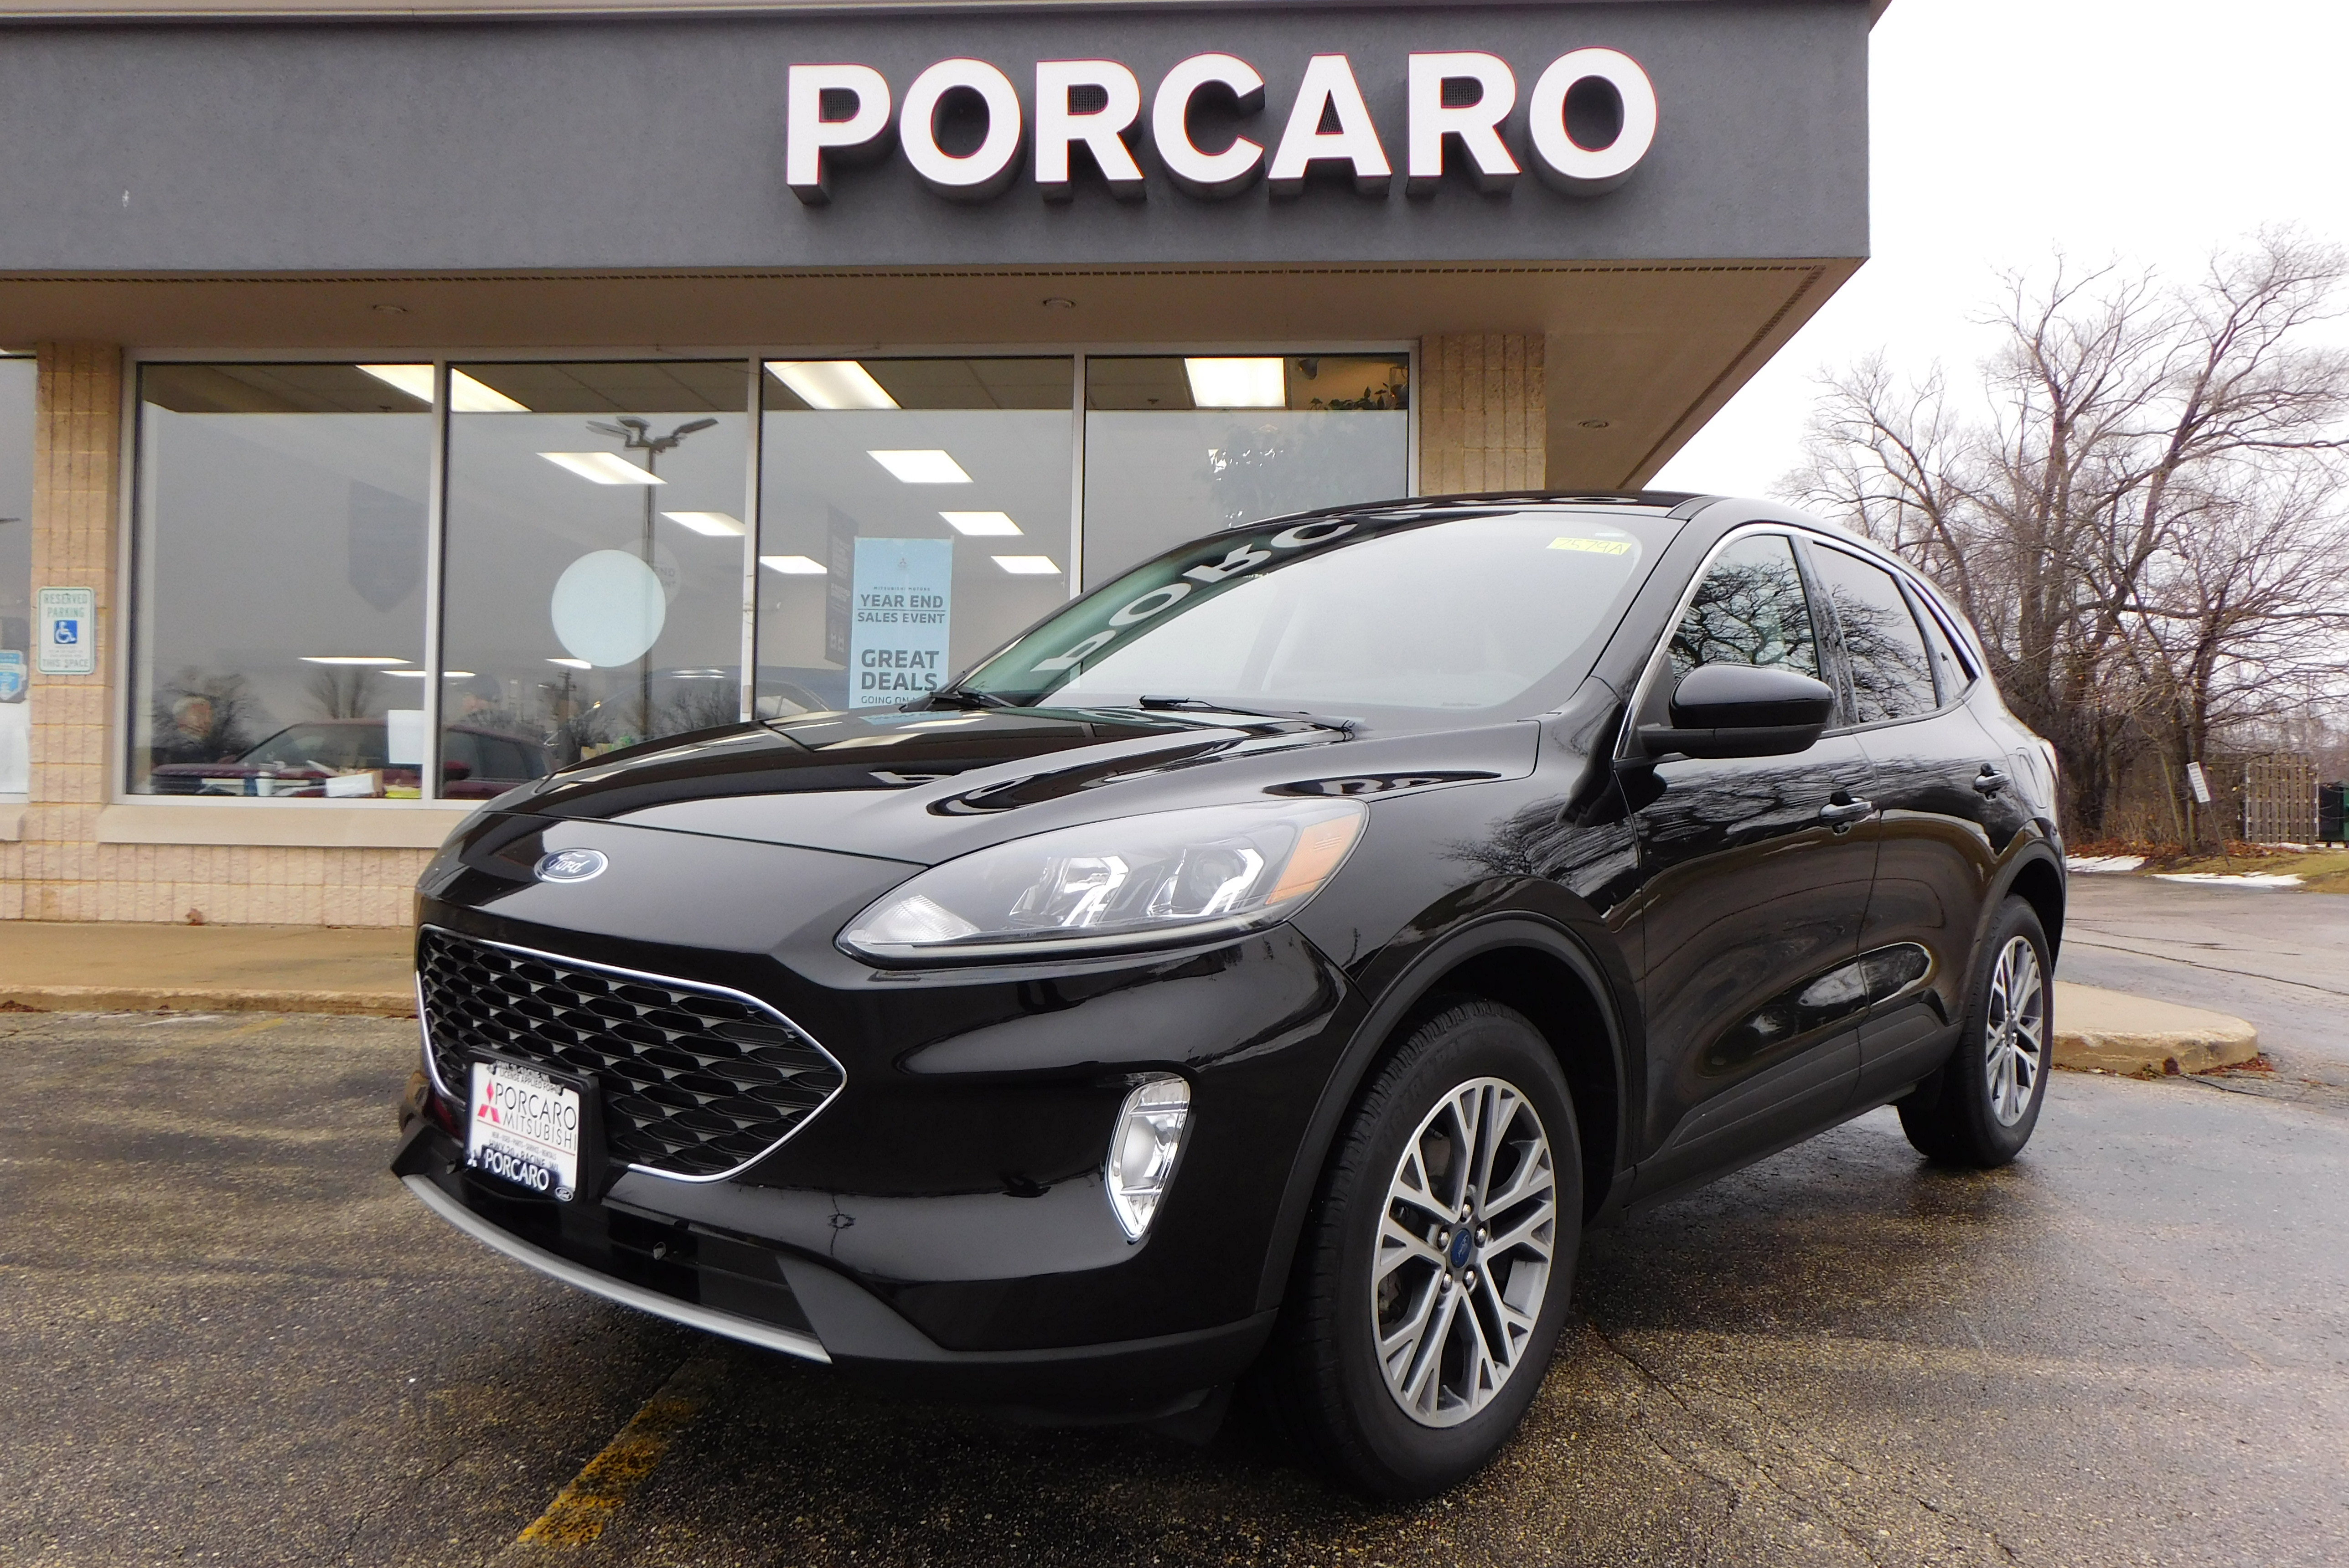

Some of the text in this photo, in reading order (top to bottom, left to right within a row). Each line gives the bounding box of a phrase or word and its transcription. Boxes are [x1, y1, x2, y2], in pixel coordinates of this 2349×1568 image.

[786, 46, 1659, 187] PORCARO
[1555, 539, 1624, 555] 7579A
[43, 593, 88, 604] RESERVED
[860, 594, 943, 609] YEAR END
[47, 607, 85, 618] PARKING
[857, 612, 946, 624] SALES EVENT
[42, 659, 89, 668] THIS SPACE
[861, 649, 940, 669] GREAT
[861, 671, 937, 691] DEALS
[861, 696, 892, 704] GOING
[548, 852, 591, 874] Ford
[495, 1082, 577, 1130] PORCARO
[503, 1111, 576, 1151] MITSUBISHI
[485, 1148, 550, 1191] PORCARO
